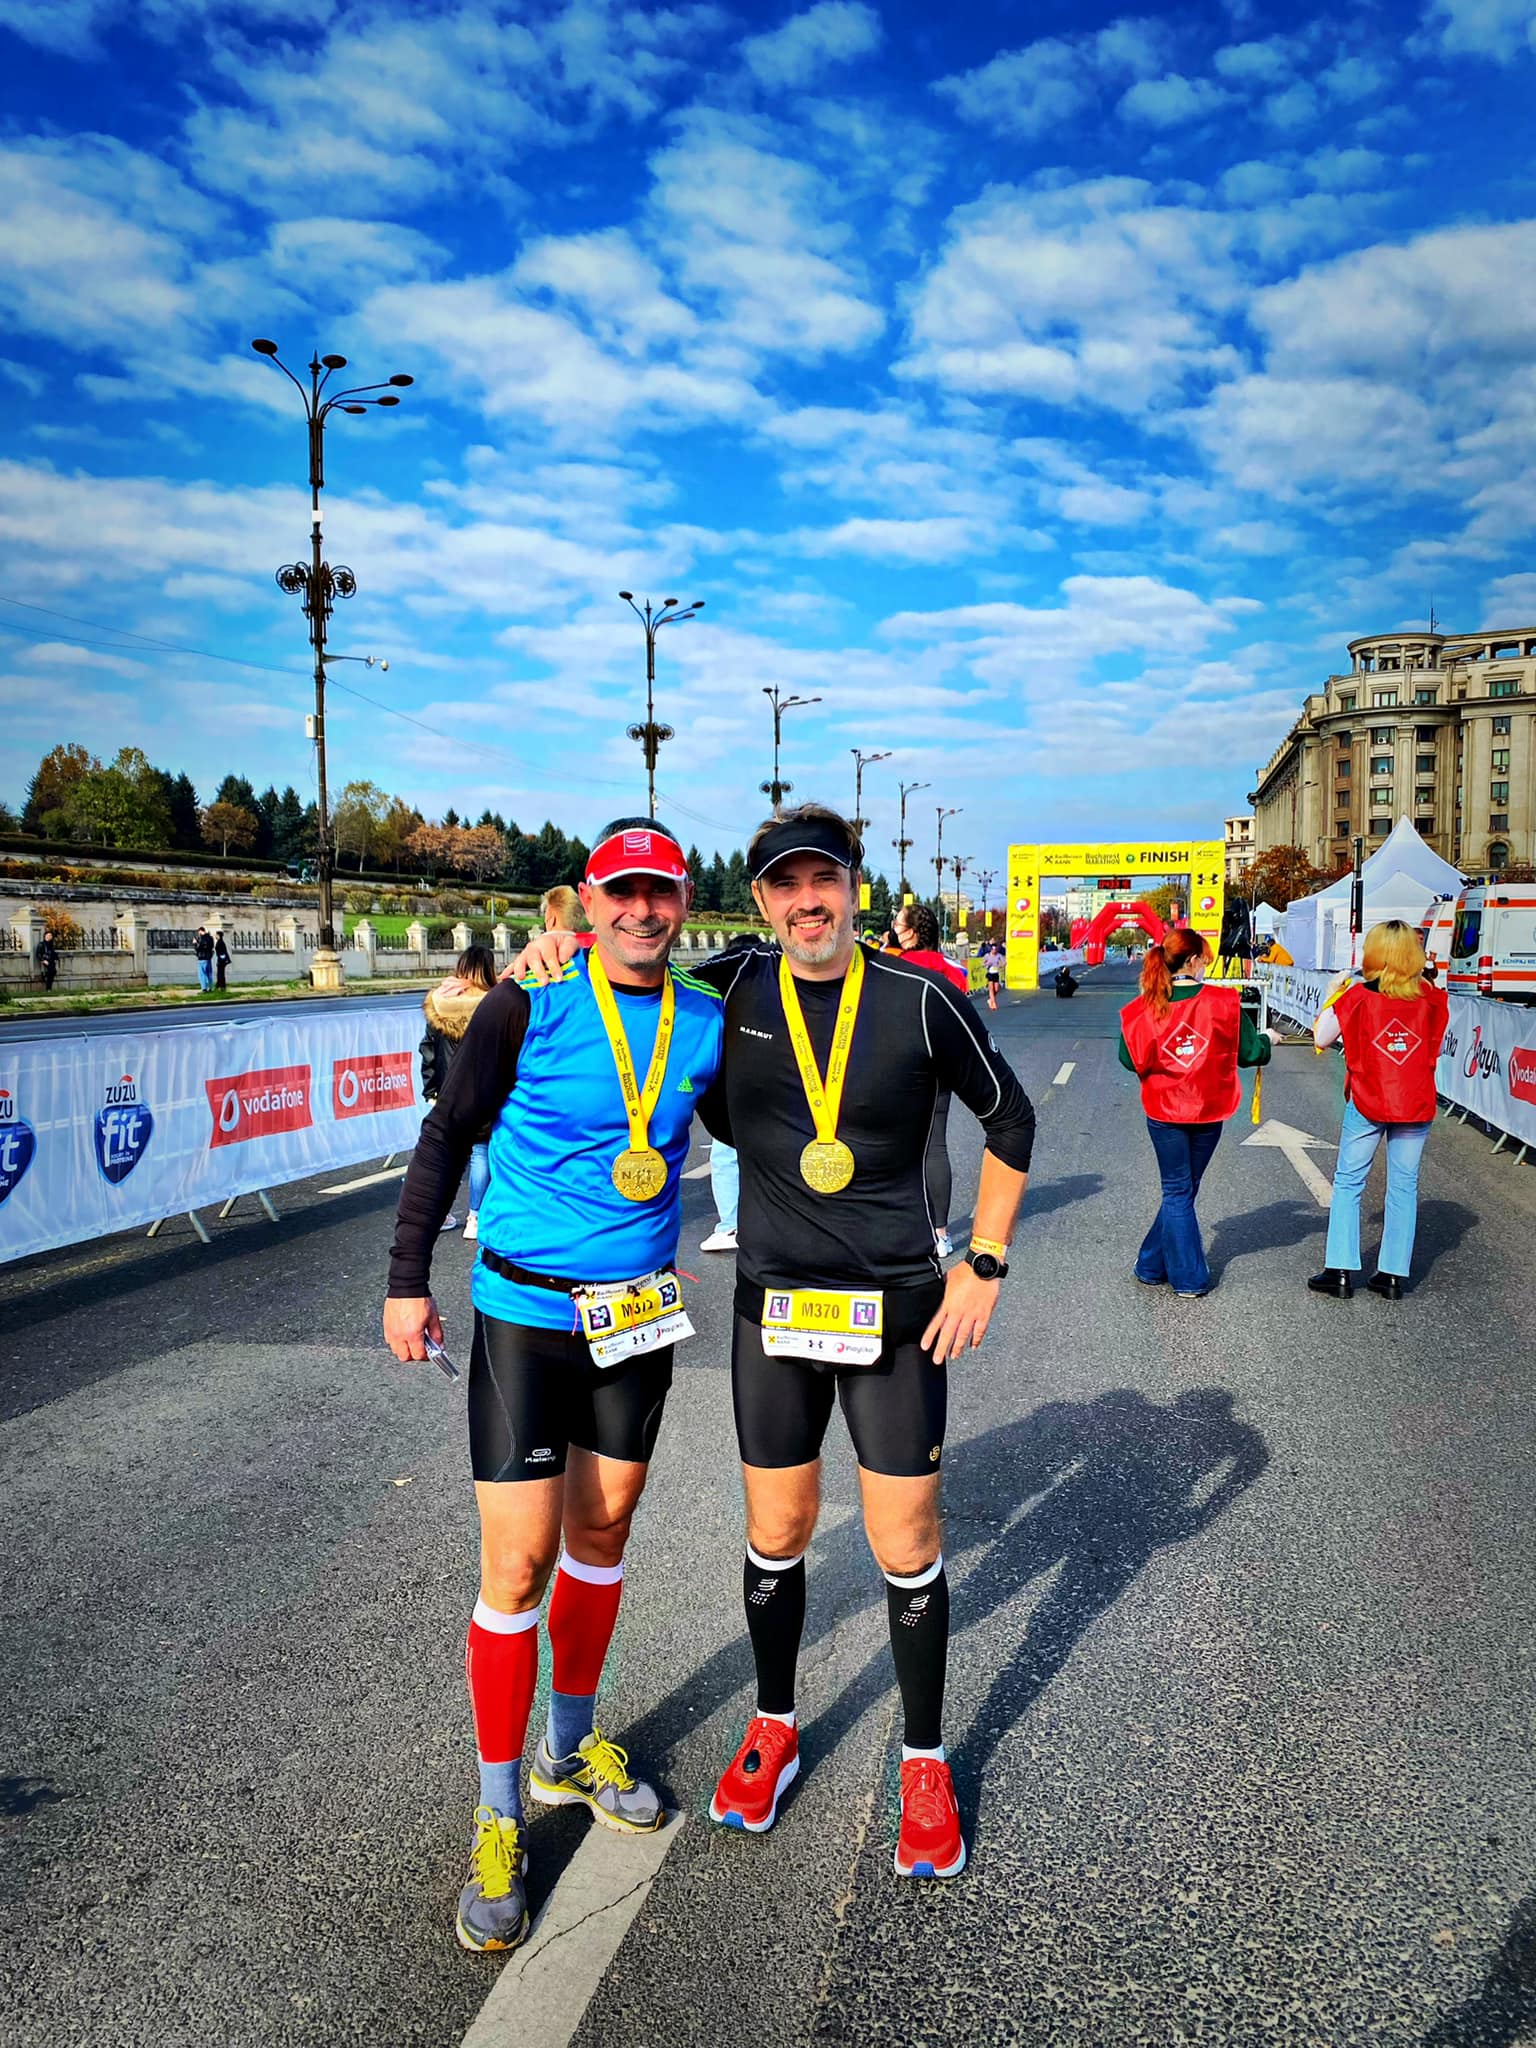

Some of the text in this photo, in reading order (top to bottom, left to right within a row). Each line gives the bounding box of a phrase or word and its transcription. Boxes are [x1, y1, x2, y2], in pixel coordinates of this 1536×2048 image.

[1140, 851, 1189, 863] FINISH
[739, 1026, 773, 1040] MAMMUT
[106, 1084, 136, 1104] ZUZU
[243, 1087, 303, 1115] vodafone
[101, 1111, 142, 1168] fit
[801, 1302, 840, 1320] M370
